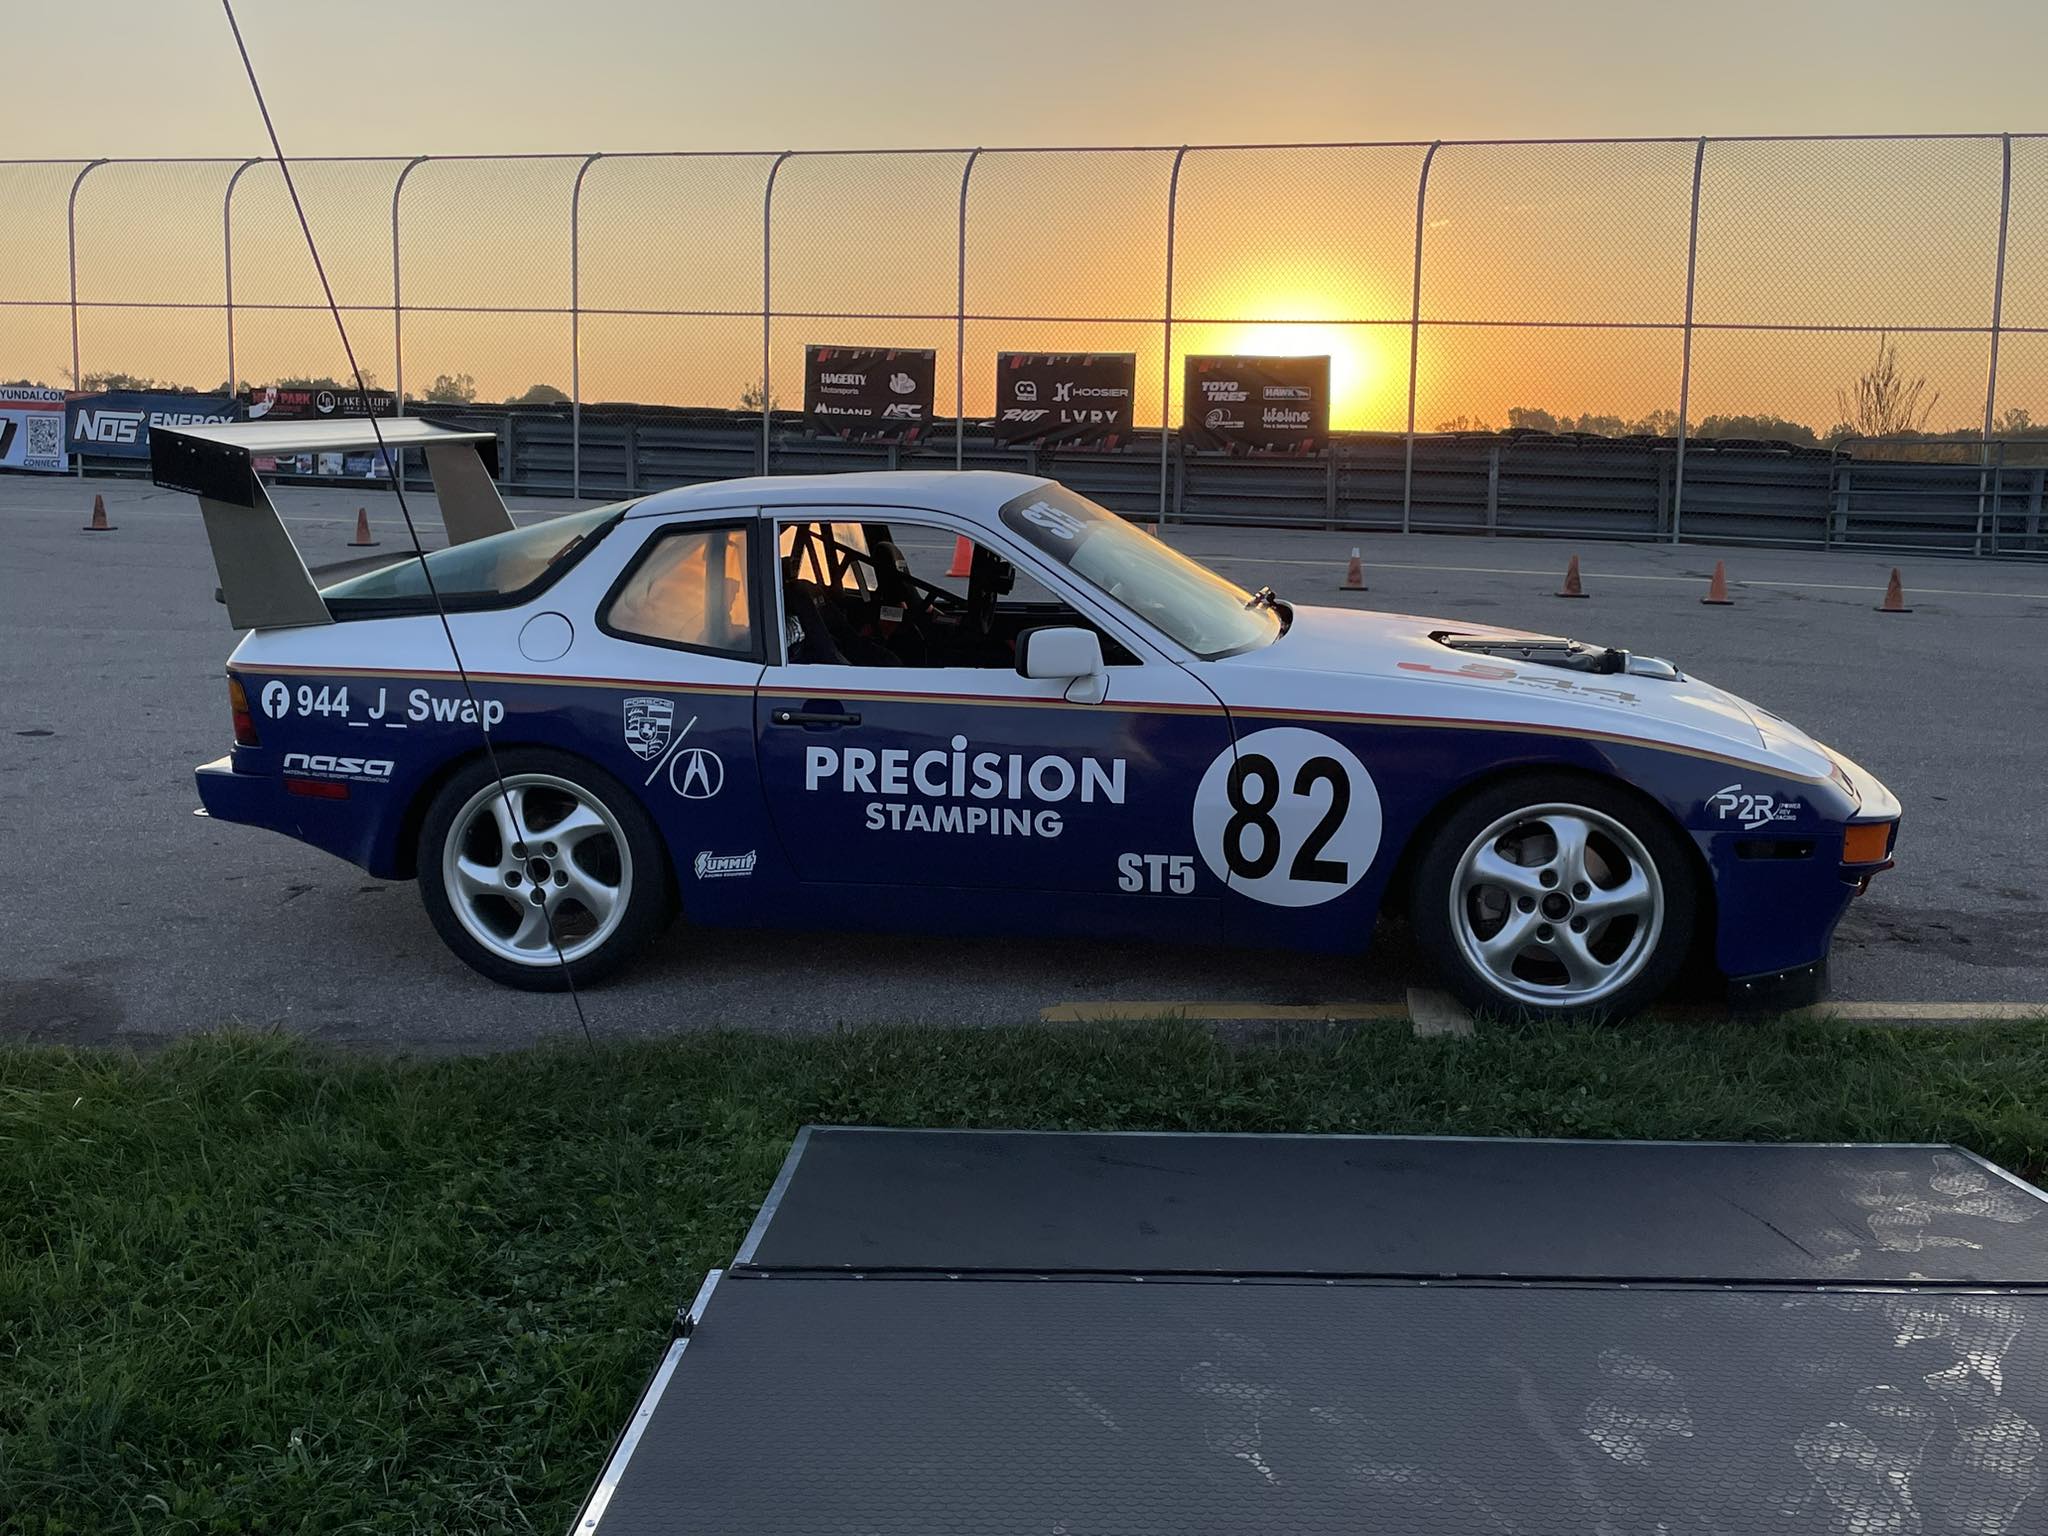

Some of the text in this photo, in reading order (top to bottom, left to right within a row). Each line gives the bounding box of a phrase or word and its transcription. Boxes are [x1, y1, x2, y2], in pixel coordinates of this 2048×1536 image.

[820, 372, 867, 386] HAGERTY
[1201, 381, 1238, 391] TOYO
[1072, 388, 1128, 397] HOOSIER
[1207, 391, 1247, 401] TIRES
[1060, 409, 1118, 423] LVRY
[74, 409, 146, 443] NOS
[23, 459, 61, 468] CONNECT
[1716, 794, 1774, 820] P2R
[865, 802, 1064, 838] STAMPING
[1223, 753, 1351, 885] 82
[1117, 852, 1196, 894] ST5
